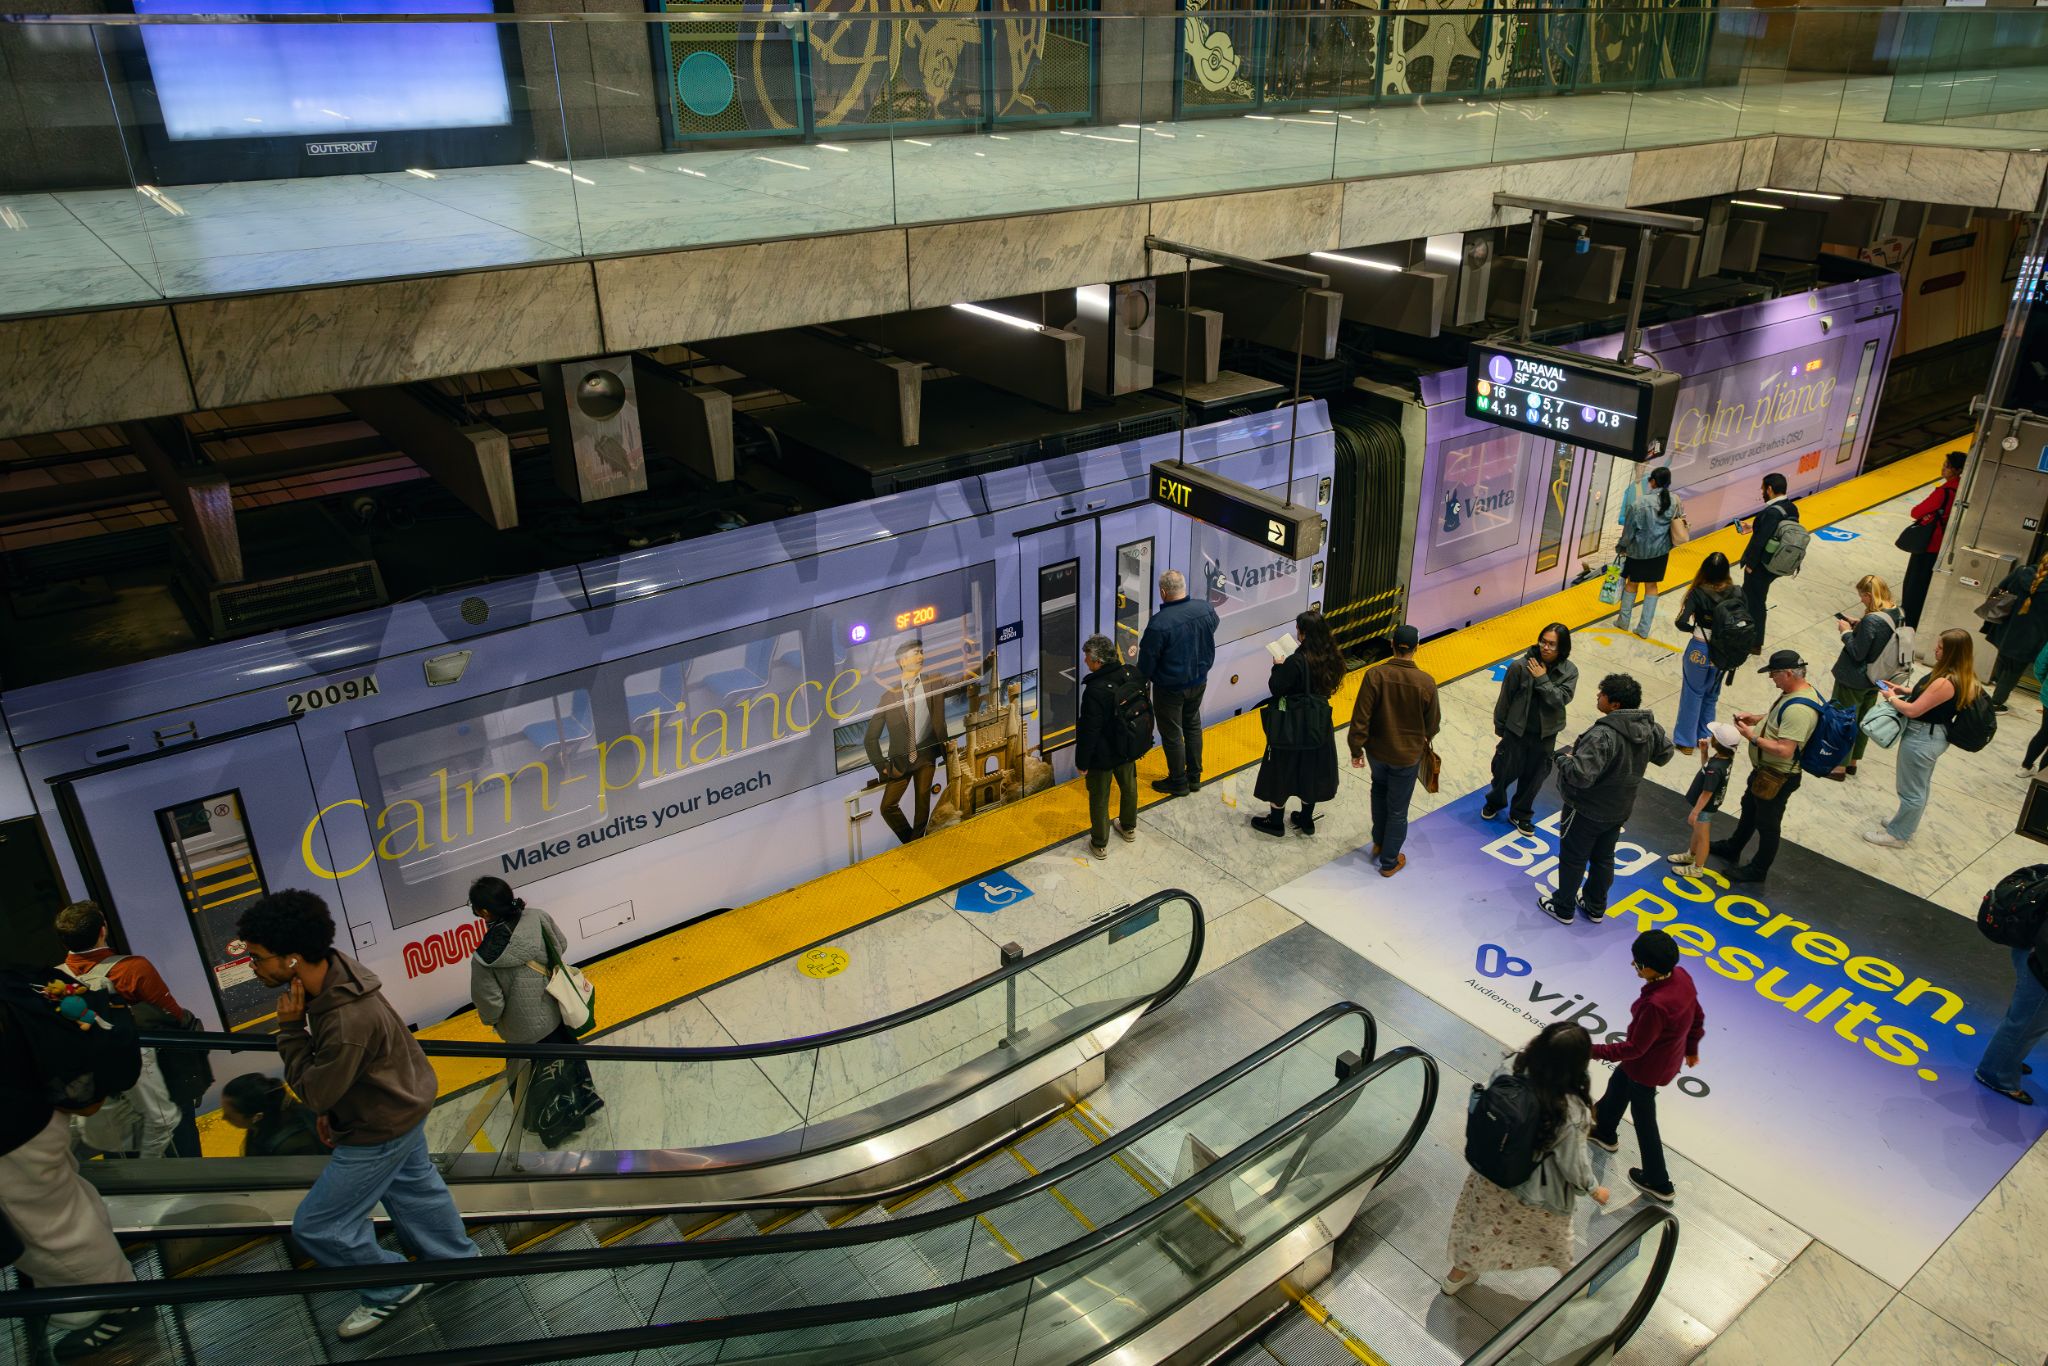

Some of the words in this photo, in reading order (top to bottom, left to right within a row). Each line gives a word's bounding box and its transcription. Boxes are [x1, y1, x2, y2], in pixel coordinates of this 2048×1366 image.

[310, 142, 372, 154] OUTFRONT
[1514, 358, 1567, 382] TARAVAL
[1514, 372, 1528, 385] SF
[1531, 374, 1558, 392] ZOO
[1493, 385, 1507, 399] 16
[1543, 397, 1553, 413] 5,
[1556, 400, 1564, 413] 7
[1491, 400, 1501, 415] 4,
[1504, 403, 1517, 417] 13
[1541, 413, 1552, 428] 4,
[1555, 416, 1569, 430] 15
[1597, 412, 1608, 427] 0,
[1611, 414, 1620, 428] 8
[1675, 376, 1837, 451] Calm-pliance
[1159, 477, 1192, 508] EXIT
[1464, 488, 1515, 518] Vanta
[1231, 556, 1298, 591] Vanta
[896, 614, 911, 629] SF
[287, 676, 378, 714] 2009A
[301, 668, 863, 880] Calm-pliance
[501, 841, 572, 874] Make
[575, 811, 648, 848] audits
[652, 794, 702, 830] your
[706, 770, 772, 807] beach
[1662, 867, 1976, 1036] Screen.
[1464, 979, 1522, 1014] Audience
[1604, 888, 1939, 1082] Results.
